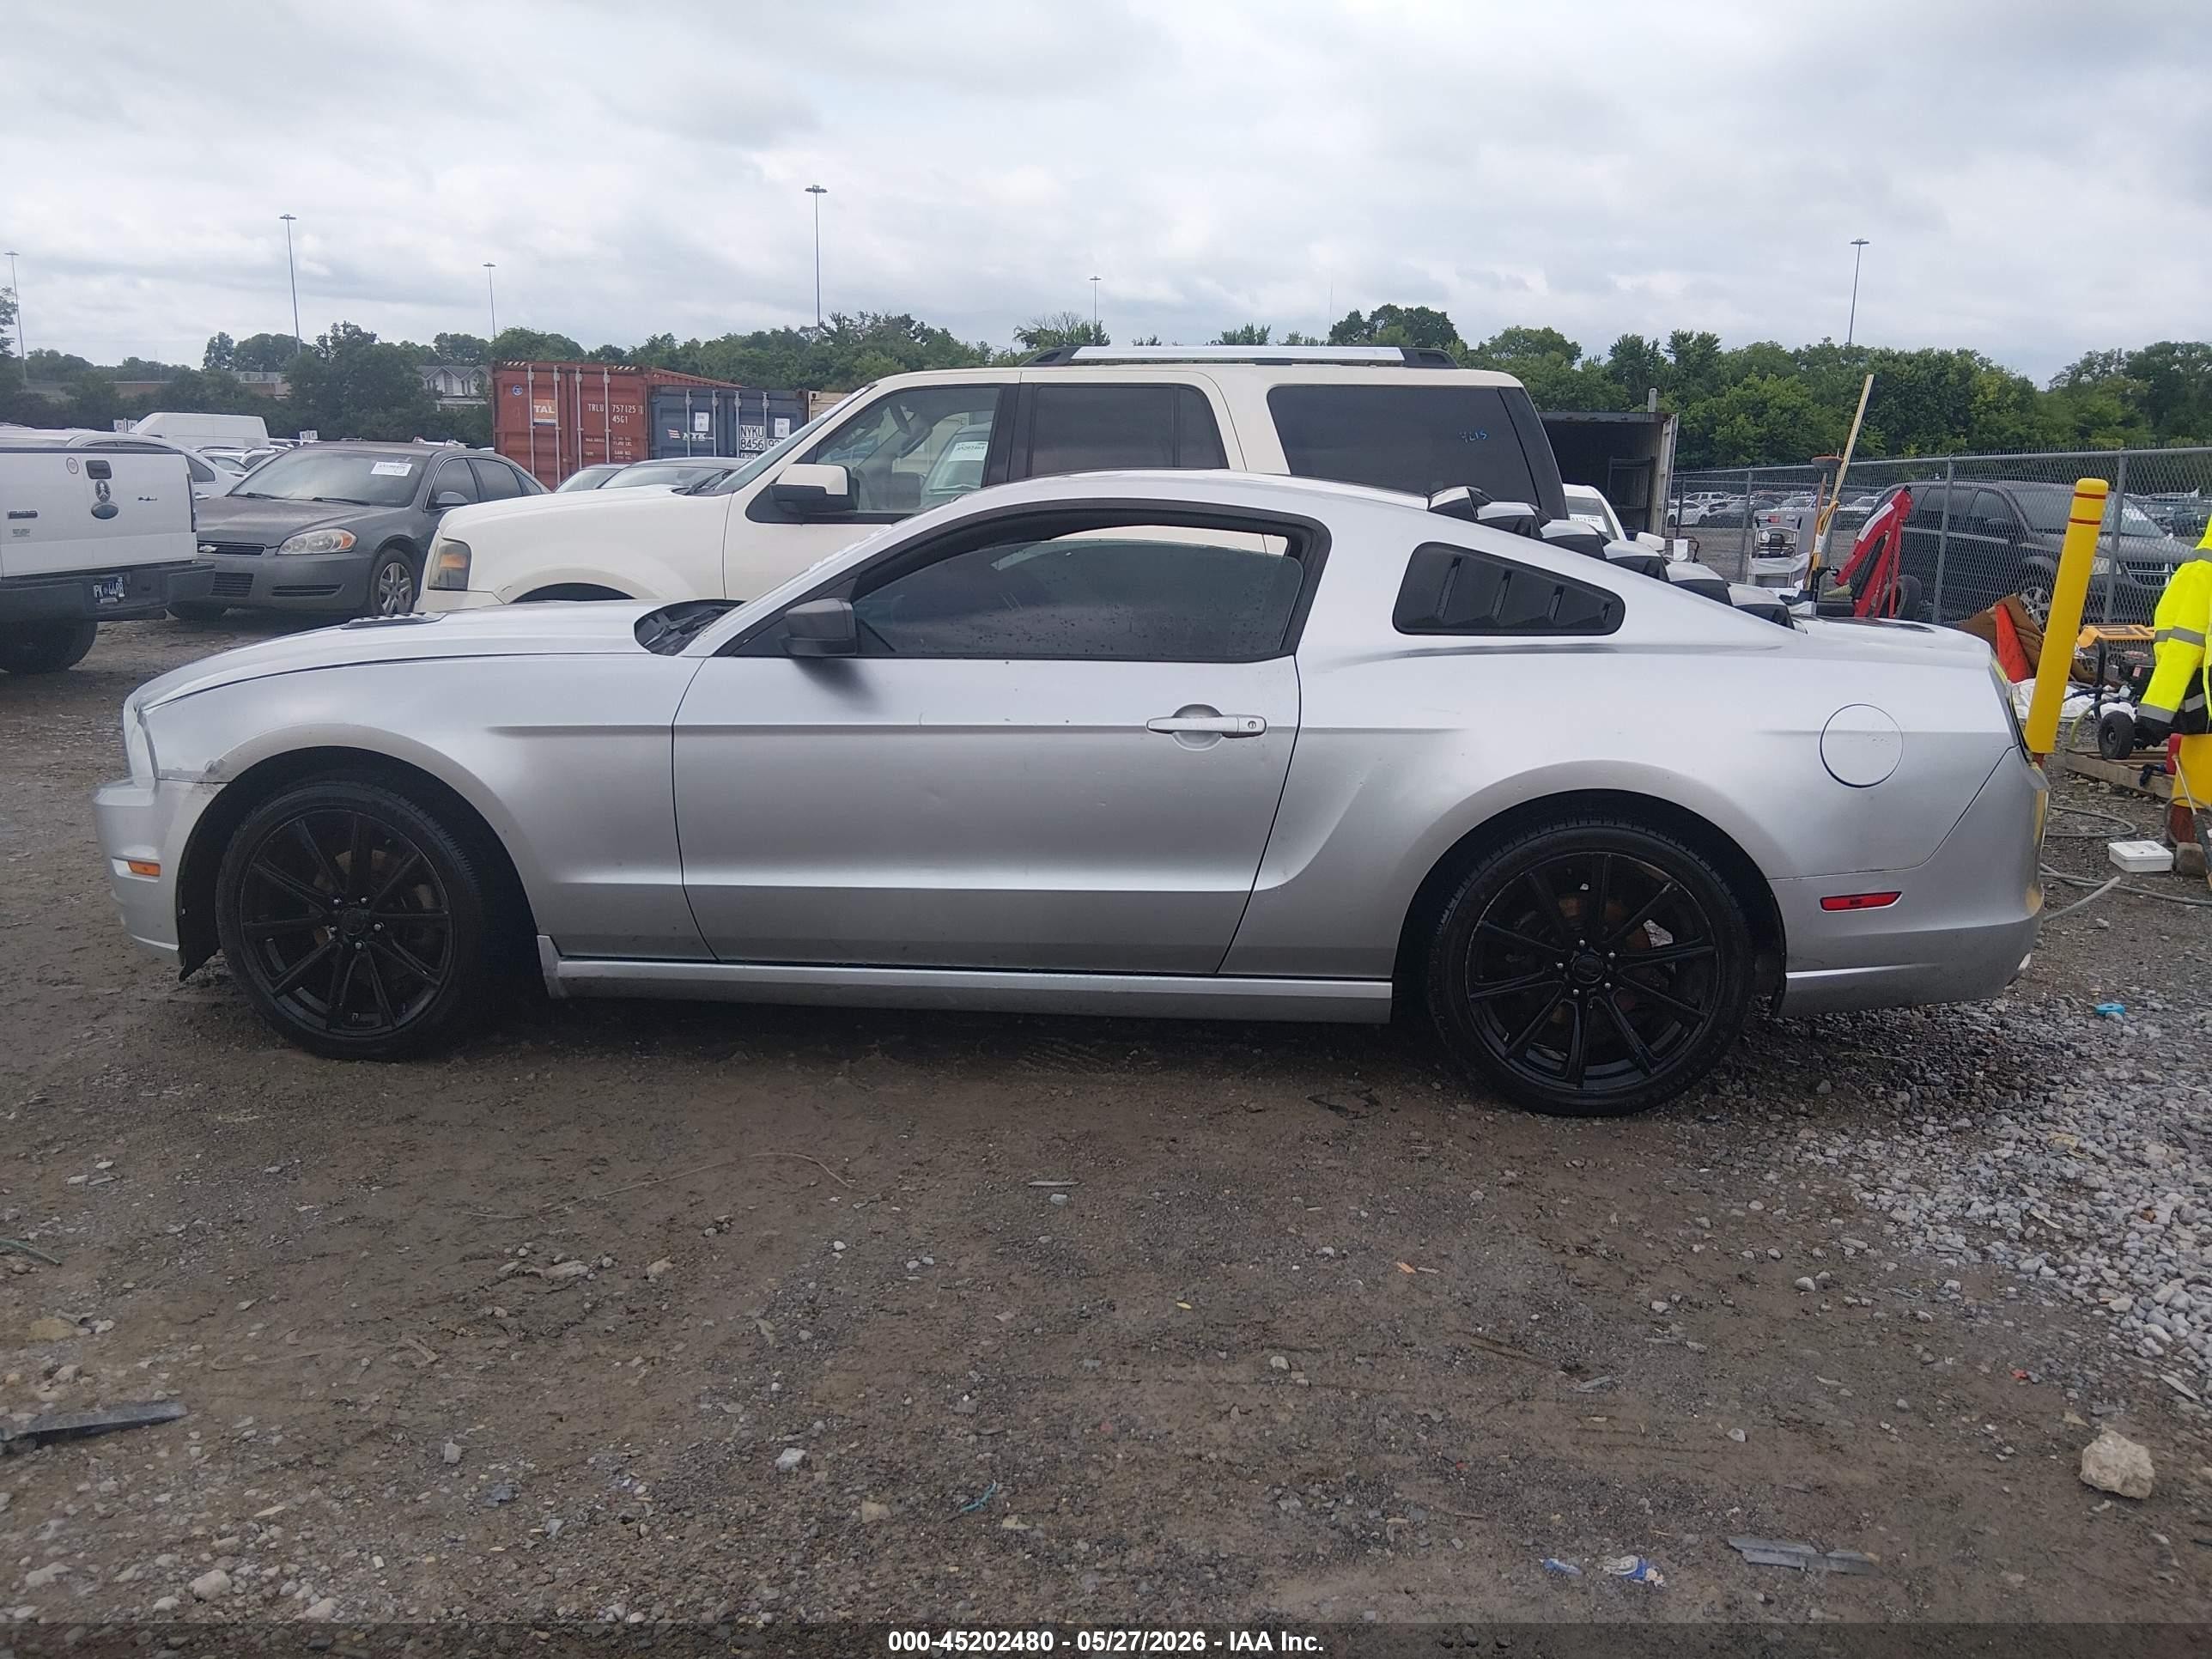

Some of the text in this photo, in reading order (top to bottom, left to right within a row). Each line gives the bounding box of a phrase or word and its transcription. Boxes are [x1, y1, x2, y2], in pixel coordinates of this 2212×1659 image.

[533, 404, 556, 414] TAL
[611, 404, 636, 414] 757125
[740, 426, 764, 438] NYKU
[740, 438, 764, 450] 8456
